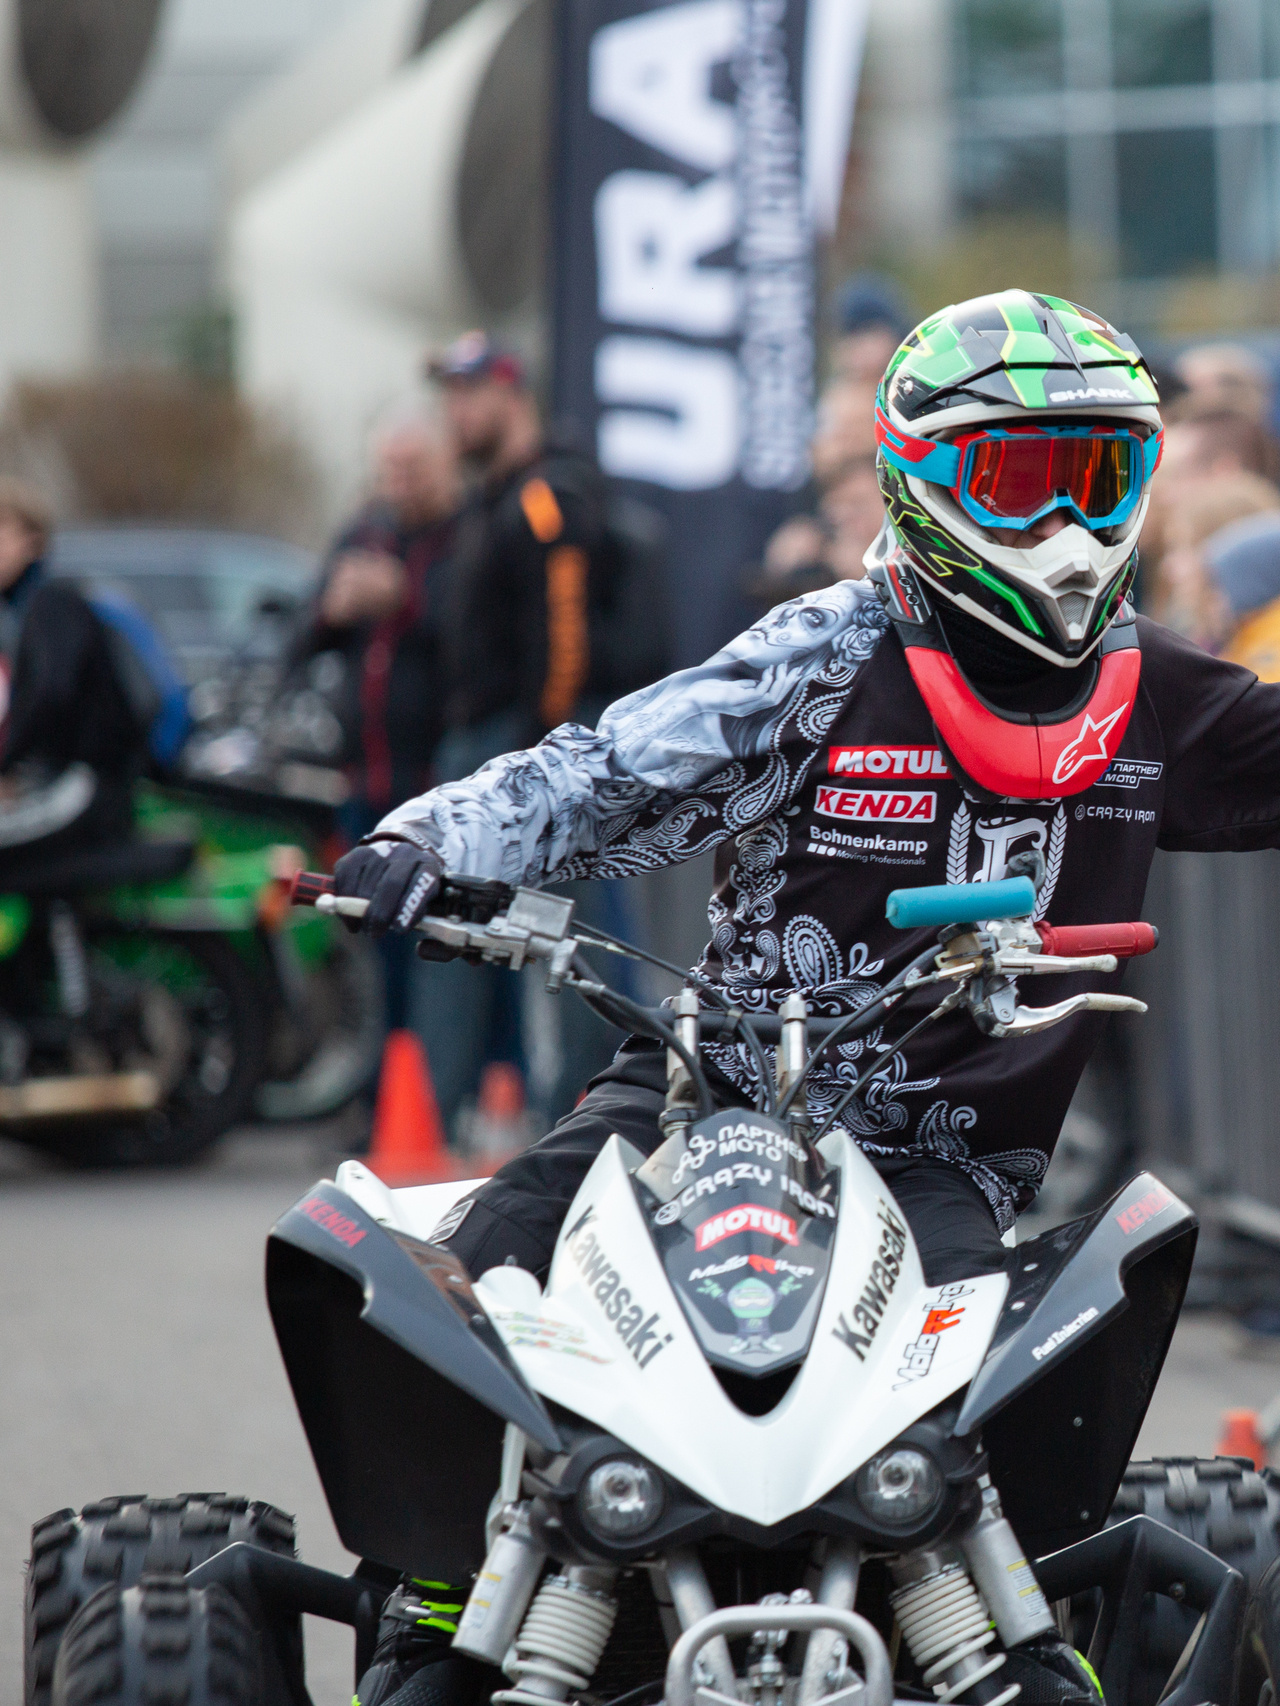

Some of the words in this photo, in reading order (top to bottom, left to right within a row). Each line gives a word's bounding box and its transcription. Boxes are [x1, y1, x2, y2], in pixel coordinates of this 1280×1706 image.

[1049, 387, 1134, 402] SHARK
[834, 750, 948, 775] MOTUL
[1113, 763, 1160, 775] ПАРТНЕР
[816, 788, 933, 820] KENDA
[1086, 806, 1133, 822] CRAZY
[810, 825, 928, 855] Bohnenkamp
[836, 849, 868, 863] Moving
[869, 854, 926, 866] Professionals
[397, 871, 436, 928] THOR
[718, 1122, 809, 1163] ПАРТНЕР
[681, 1162, 773, 1208] CRAZY
[300, 1197, 368, 1249] KENDA
[701, 1207, 794, 1248] MOTUL
[565, 1204, 674, 1371] Kawasaki
[831, 1194, 907, 1363] Kawasaki
